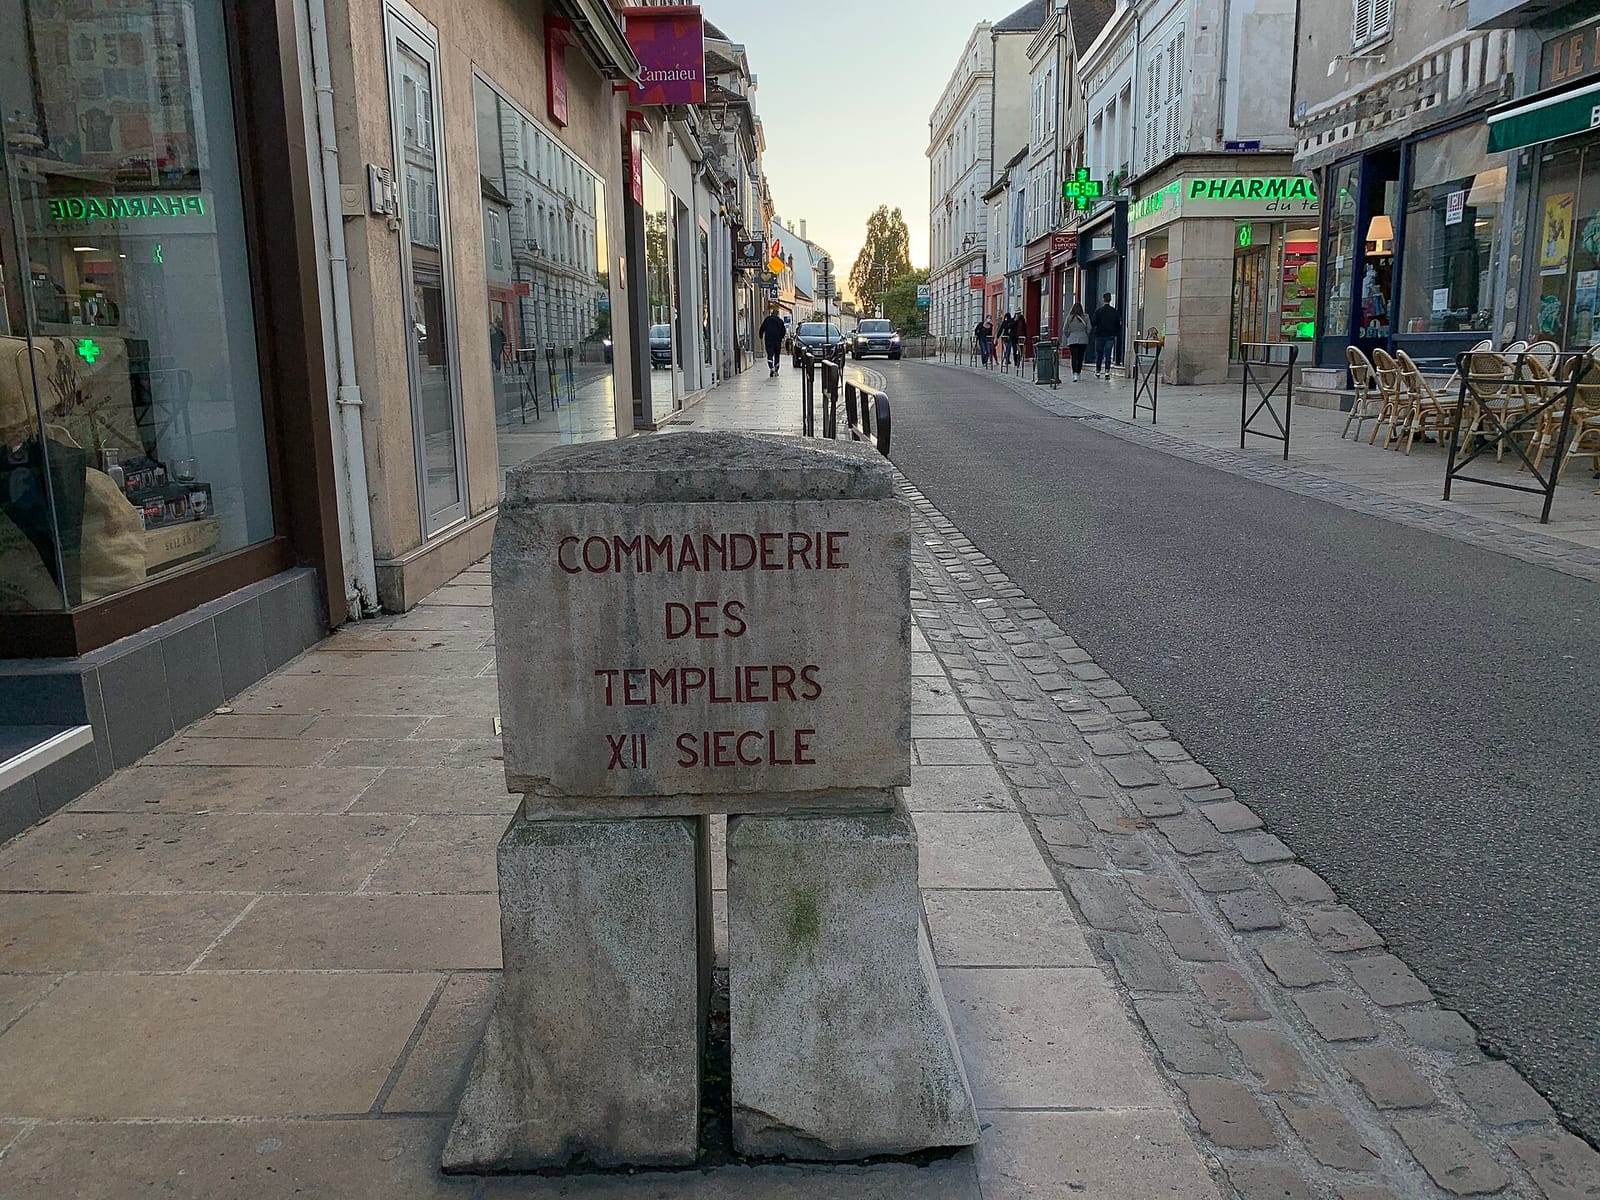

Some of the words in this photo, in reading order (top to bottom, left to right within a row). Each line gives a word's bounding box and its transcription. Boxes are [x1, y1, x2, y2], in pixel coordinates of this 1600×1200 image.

[1551, 33, 1584, 82] LE
[1066, 182, 1099, 196] 16:51
[1265, 197, 1292, 212] du
[557, 532, 850, 574] COMMANDERIE
[664, 600, 748, 640] DES
[594, 665, 823, 706] TEMPLIERS
[606, 733, 649, 771] XII
[675, 728, 817, 769] SIECLE
